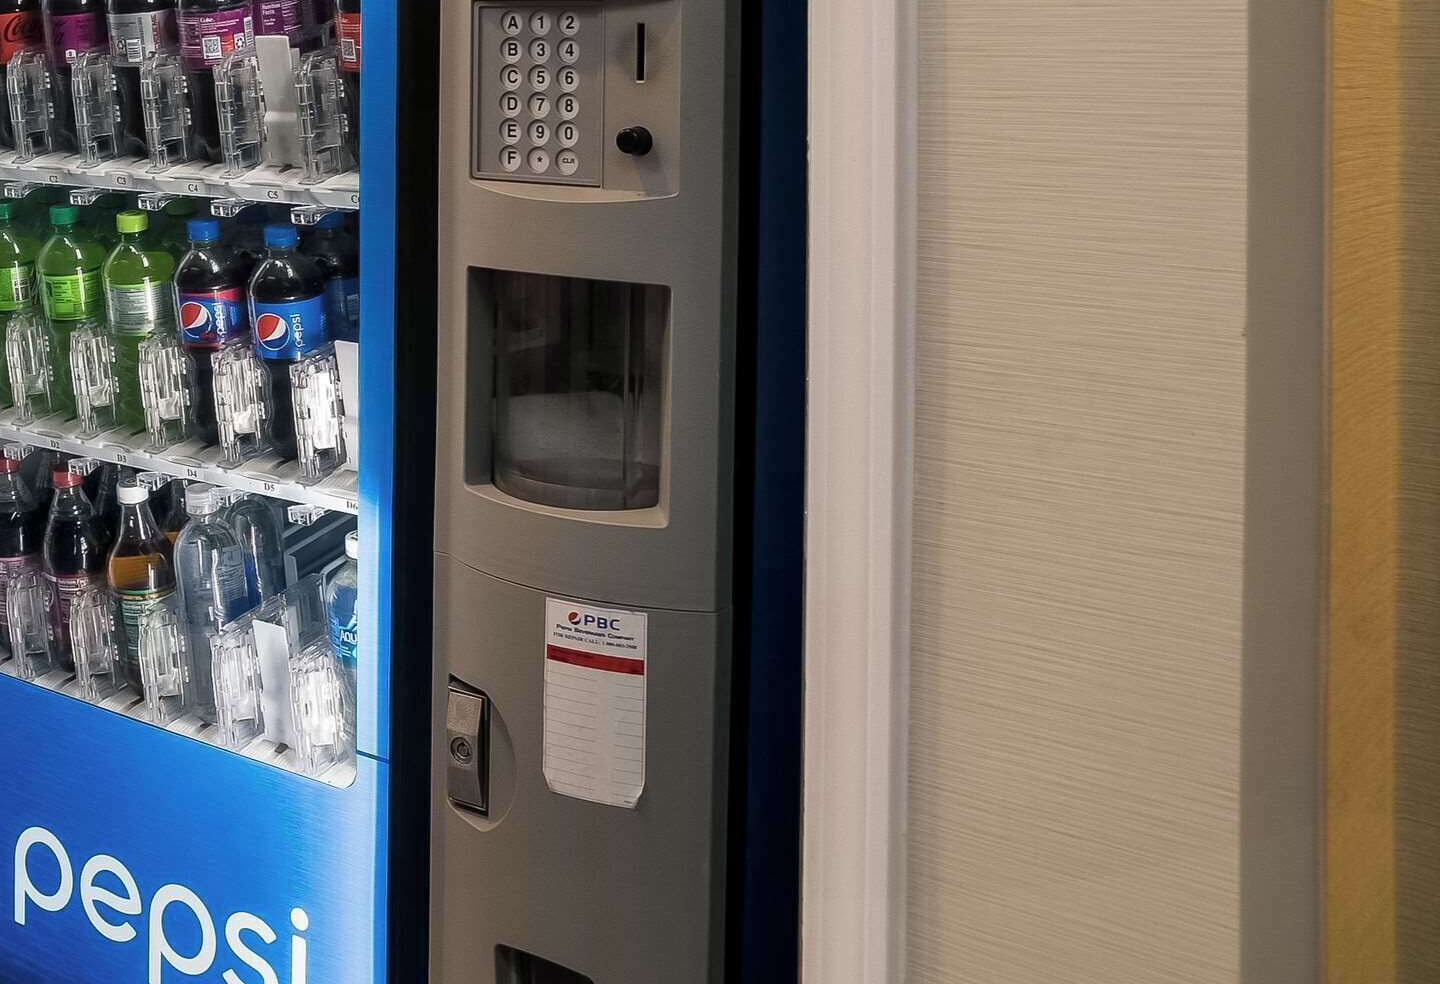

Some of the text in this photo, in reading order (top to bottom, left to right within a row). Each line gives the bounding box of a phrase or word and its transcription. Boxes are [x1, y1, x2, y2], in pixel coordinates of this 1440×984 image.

[507, 16, 519, 29] A
[538, 16, 545, 29] 1
[565, 16, 575, 29] 2
[508, 43, 518, 56] B
[536, 43, 545, 57] 3
[565, 43, 574, 57] 4
[507, 70, 518, 84] C
[536, 70, 545, 84] 5
[565, 71, 574, 85] 6
[507, 97, 518, 110] D
[536, 98, 545, 112] 7
[564, 98, 574, 113] 8
[507, 124, 517, 138] E
[536, 125, 545, 139] 9
[564, 126, 573, 140] 0
[507, 151, 517, 165] F
[562, 157, 575, 165] CLR
[187, 183, 198, 193] C4
[212, 303, 226, 337] pepsi
[289, 313, 305, 348] pepsi
[117, 453, 127, 462] D3
[584, 614, 620, 631] PBC
[14, 826, 309, 984] pepsi
